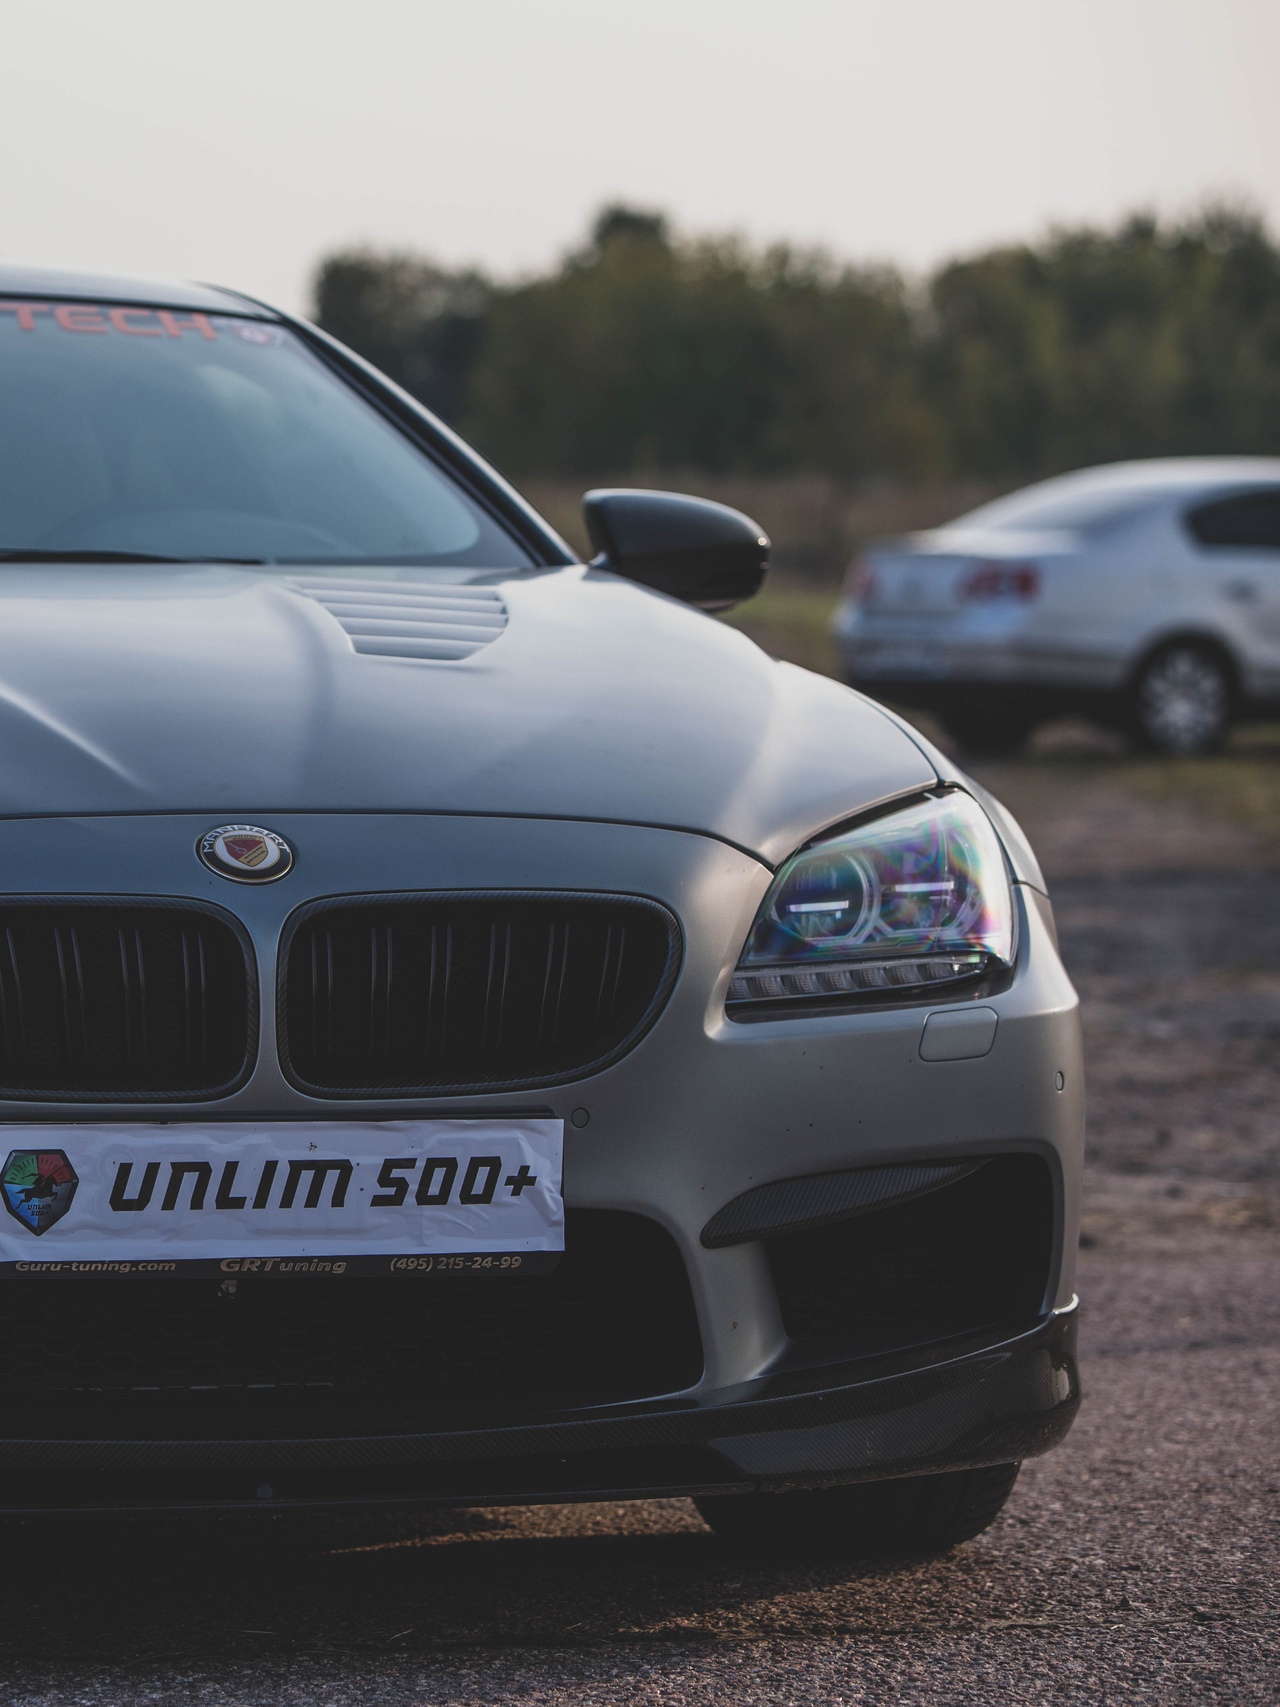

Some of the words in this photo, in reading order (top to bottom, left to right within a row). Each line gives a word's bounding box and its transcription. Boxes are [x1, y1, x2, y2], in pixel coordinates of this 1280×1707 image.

[202, 825, 290, 853] MANHART
[108, 1158, 354, 1212] UNLIM
[370, 1156, 538, 1207] 500+
[27, 1203, 52, 1211] UNLIM
[15, 1259, 176, 1273] Guru-tuning.com
[390, 1257, 433, 1271] (495)
[437, 1256, 522, 1269] 215-24-99
